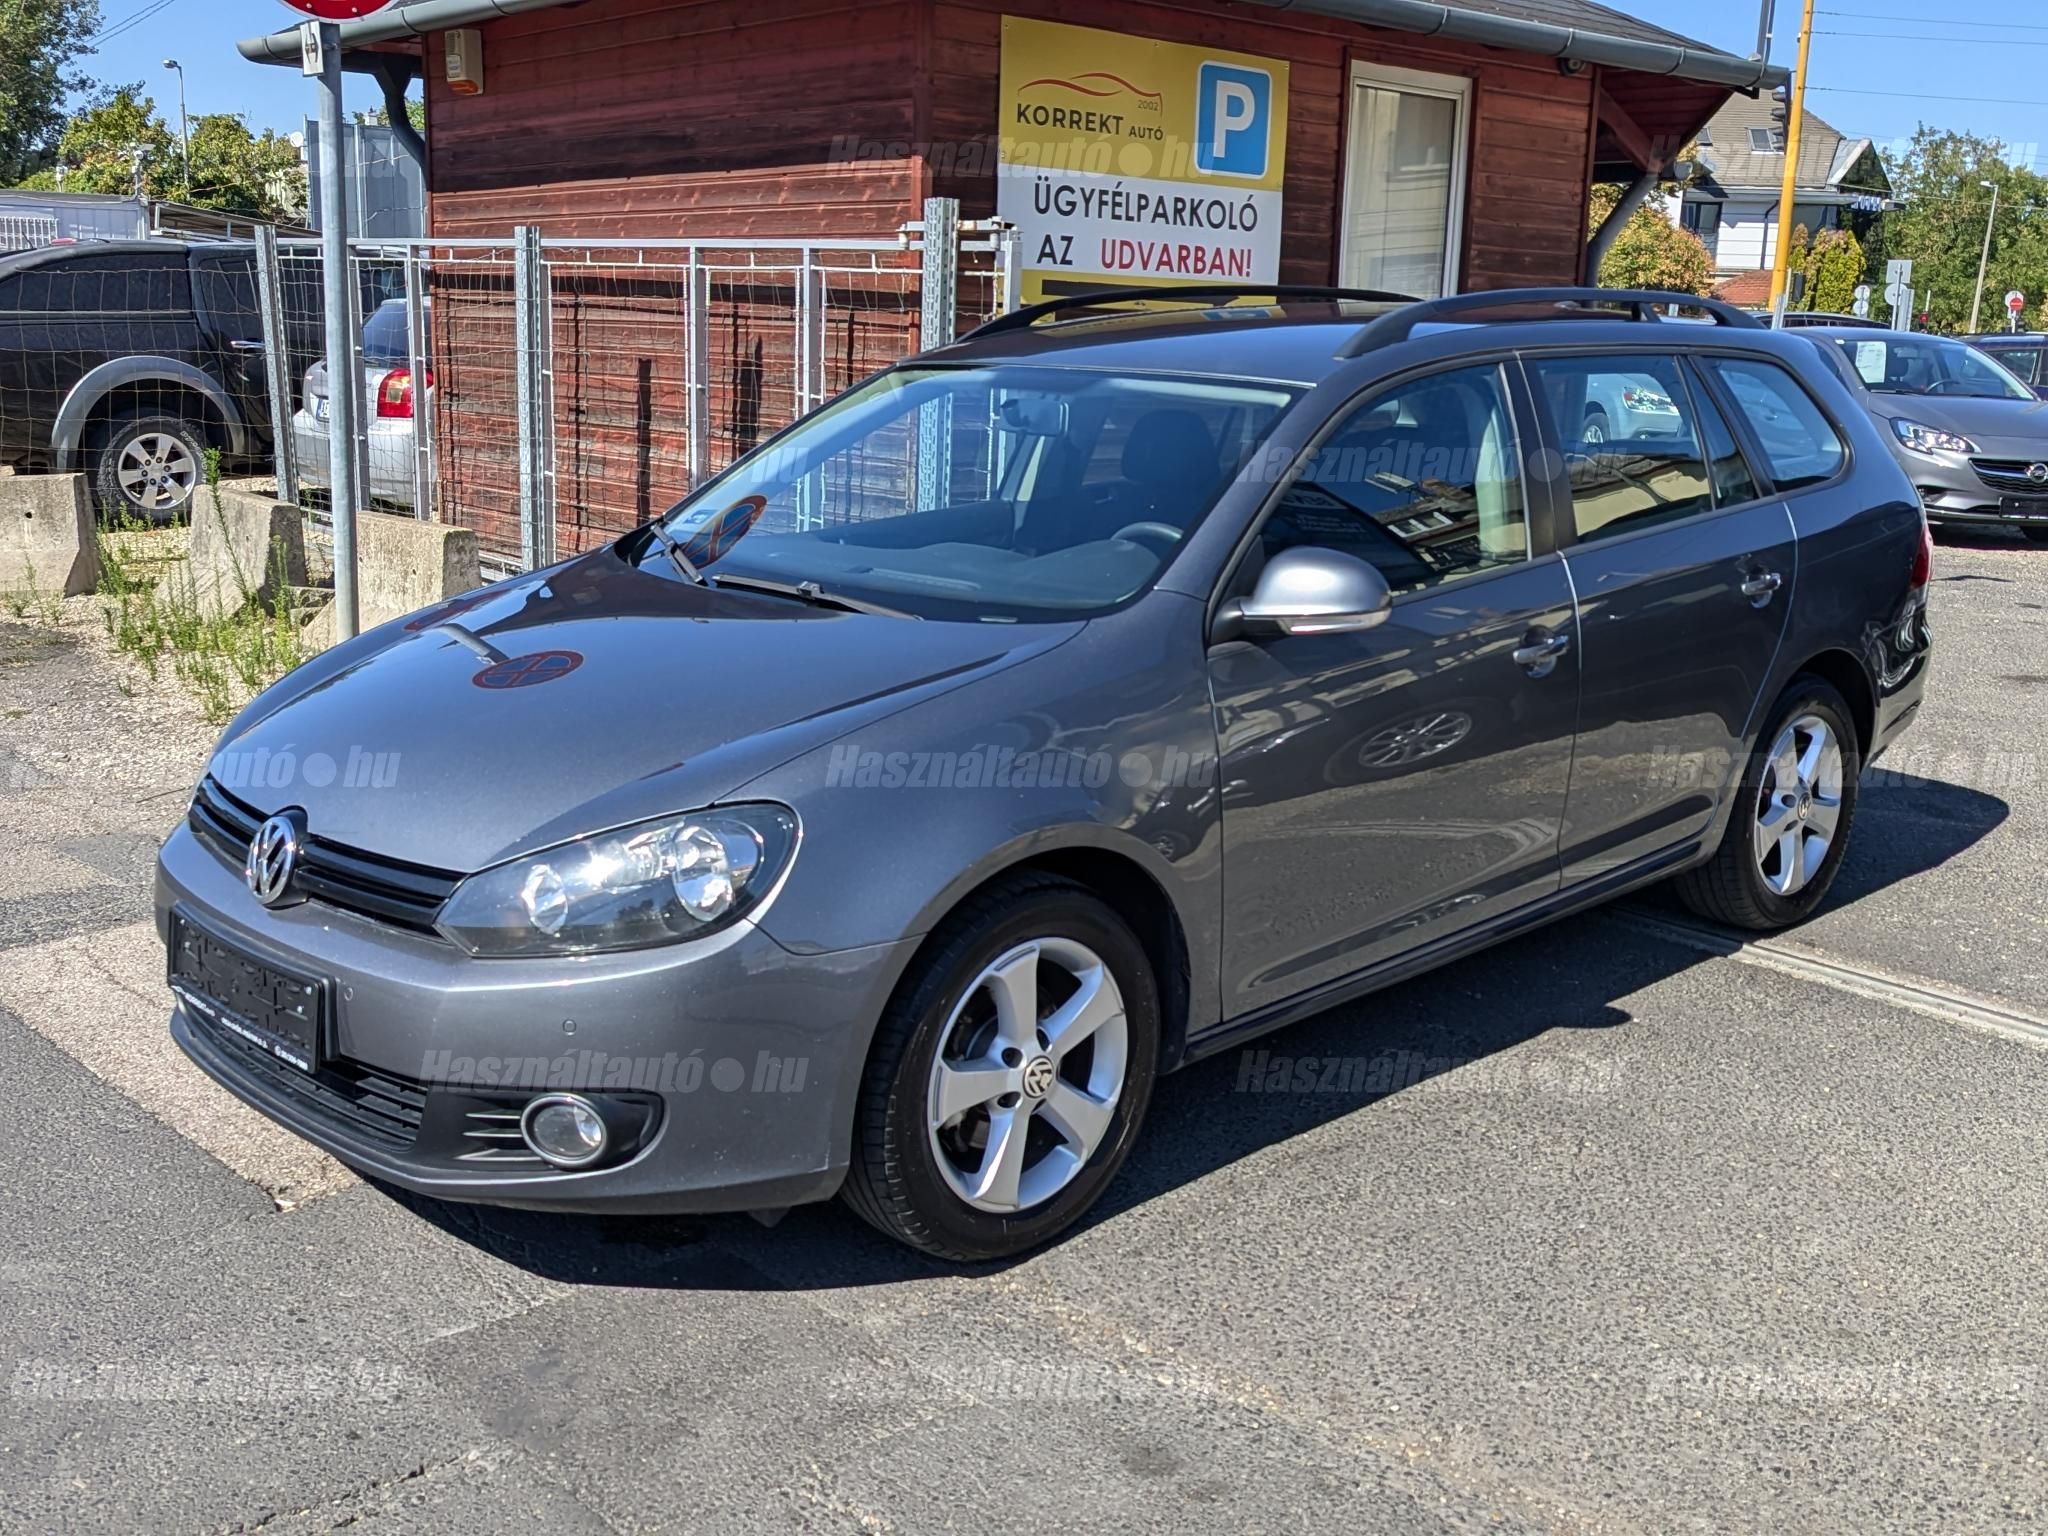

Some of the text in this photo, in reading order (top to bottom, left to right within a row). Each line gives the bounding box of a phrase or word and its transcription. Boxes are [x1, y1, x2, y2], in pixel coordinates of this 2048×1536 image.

[1016, 102, 1164, 141] KORREKT AUTÓ
[1137, 99, 1159, 112] 2002
[1212, 79, 1257, 158] P
[1033, 175, 1259, 233] ÜGYFÉLPARKOLÓ
[1036, 233, 1252, 278] AZ UDVARBAN!
